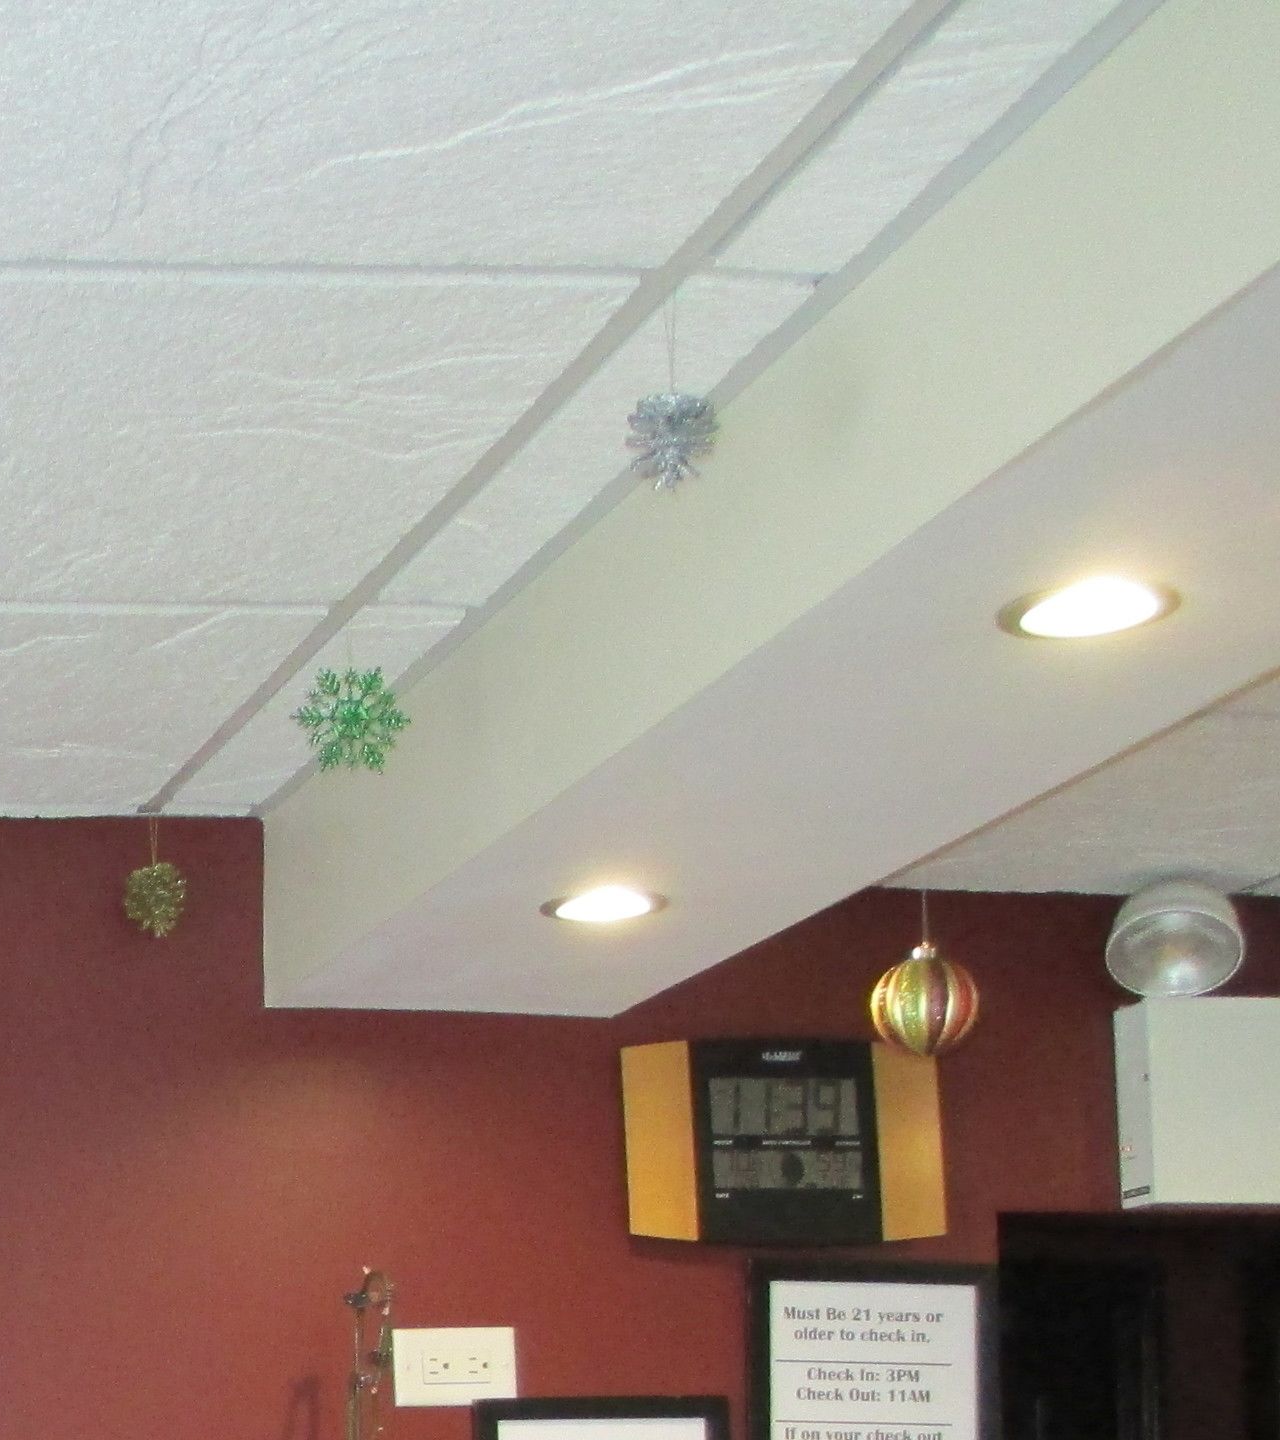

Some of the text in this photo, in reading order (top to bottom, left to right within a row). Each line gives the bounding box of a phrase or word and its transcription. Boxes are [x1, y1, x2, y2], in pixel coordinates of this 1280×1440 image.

[784, 1306, 943, 1324] Must Be 21 years or
[794, 1328, 930, 1343] older to check in.
[807, 1367, 919, 1383] Check In: 3PM
[796, 1388, 930, 1403] Check Out: 11AM
[785, 1427, 797, 1440] If
[802, 1430, 820, 1440] on
